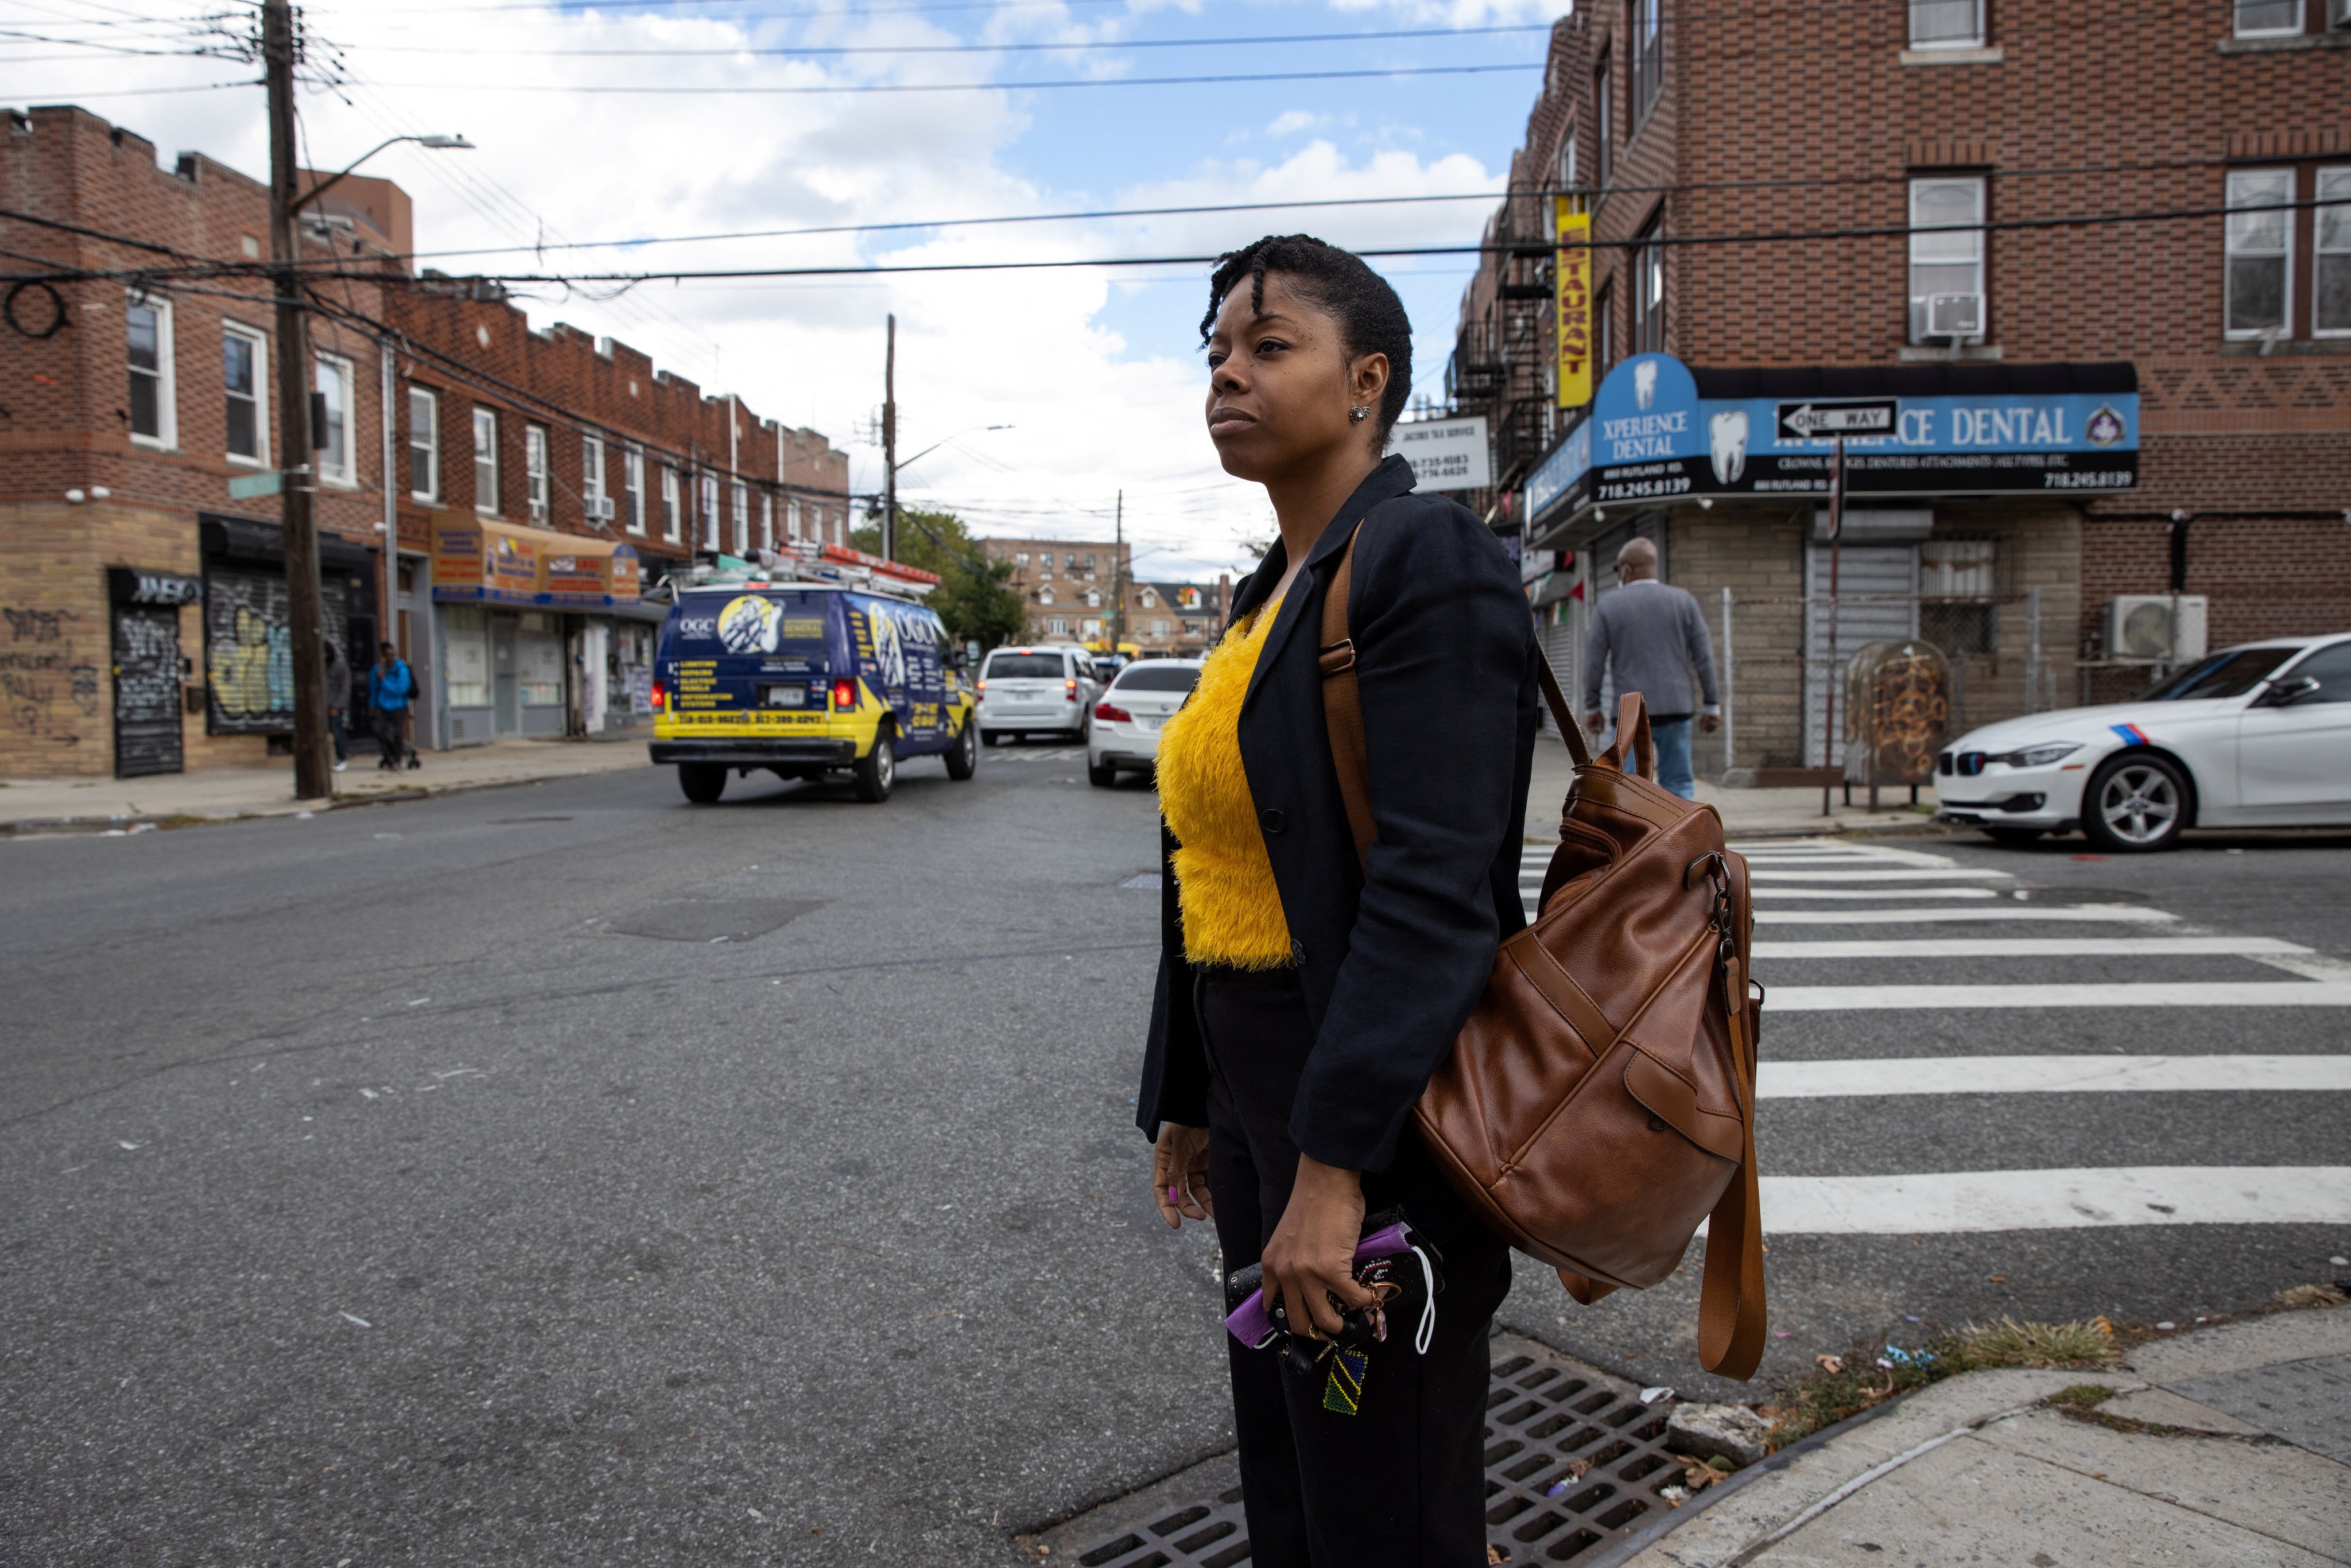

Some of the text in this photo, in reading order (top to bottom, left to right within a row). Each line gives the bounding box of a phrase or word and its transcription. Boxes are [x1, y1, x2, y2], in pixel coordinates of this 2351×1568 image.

[1603, 411, 1688, 441] XPERIENCE
[1795, 409, 1883, 429] ONE WAY
[1952, 407, 2071, 446] DENTAL
[1446, 425, 1475, 437] SERVICE
[1613, 436, 1675, 460] DENTAL
[1598, 477, 1691, 500] 718.245.8139
[2044, 471, 2133, 488] 718.245.8139
[680, 618, 716, 633] OGC
